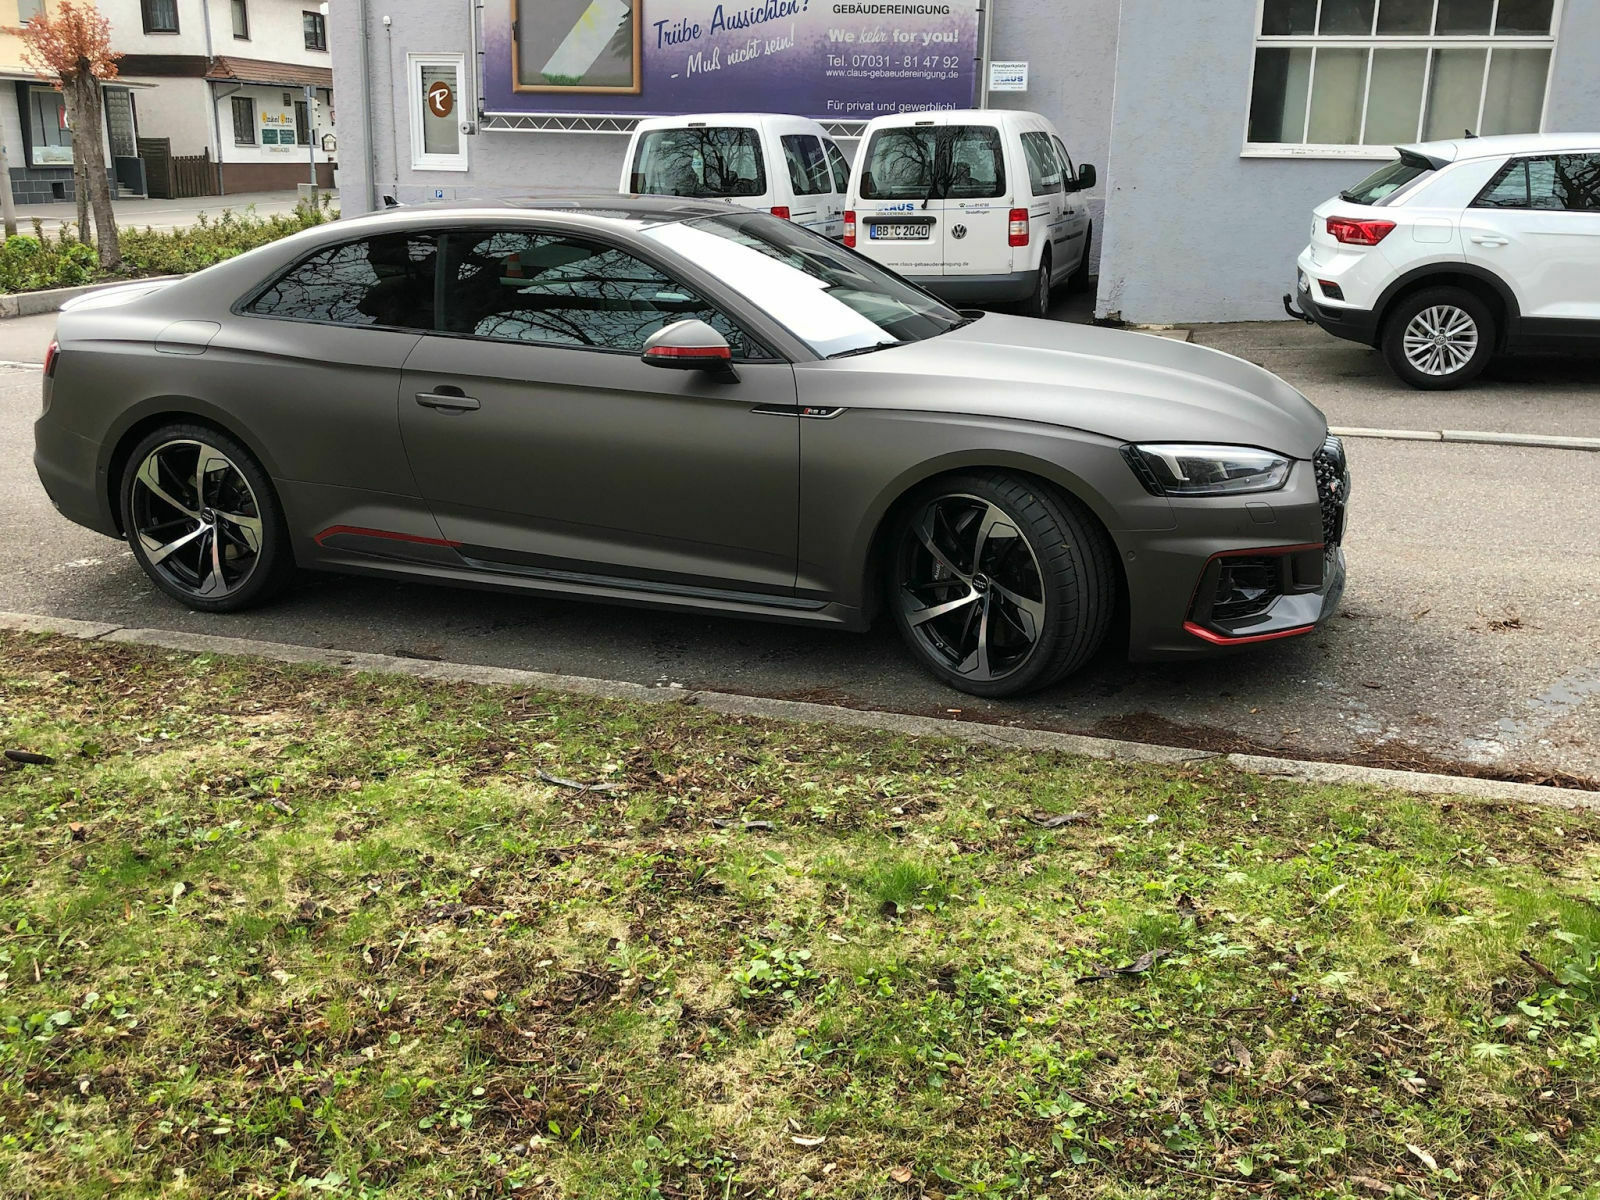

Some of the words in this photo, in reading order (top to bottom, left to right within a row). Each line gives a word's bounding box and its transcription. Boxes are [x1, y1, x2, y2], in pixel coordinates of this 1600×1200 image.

[832, 2, 950, 15] GEBÄUDEREINIGUNG
[653, 18, 702, 49] Trübe
[828, 29, 855, 42] We
[859, 25, 888, 43] kehr
[892, 28, 918, 42] for
[922, 29, 959, 46] you!
[687, 46, 721, 78] Muß
[727, 39, 761, 66] nicht
[764, 22, 795, 55] sein!
[827, 54, 848, 67] Tel.
[852, 55, 890, 68] 07031
[903, 56, 918, 67] 81
[922, 56, 939, 67] 47
[942, 56, 959, 69] 92
[826, 69, 959, 80] www.claus-gebaeudereinigung.de
[827, 100, 843, 111] Für
[846, 101, 875, 114] privat
[877, 101, 896, 111] und
[898, 101, 957, 113] gewerblich!
[876, 225, 889, 236] BB
[894, 225, 901, 236] C
[903, 225, 928, 236] 2040
